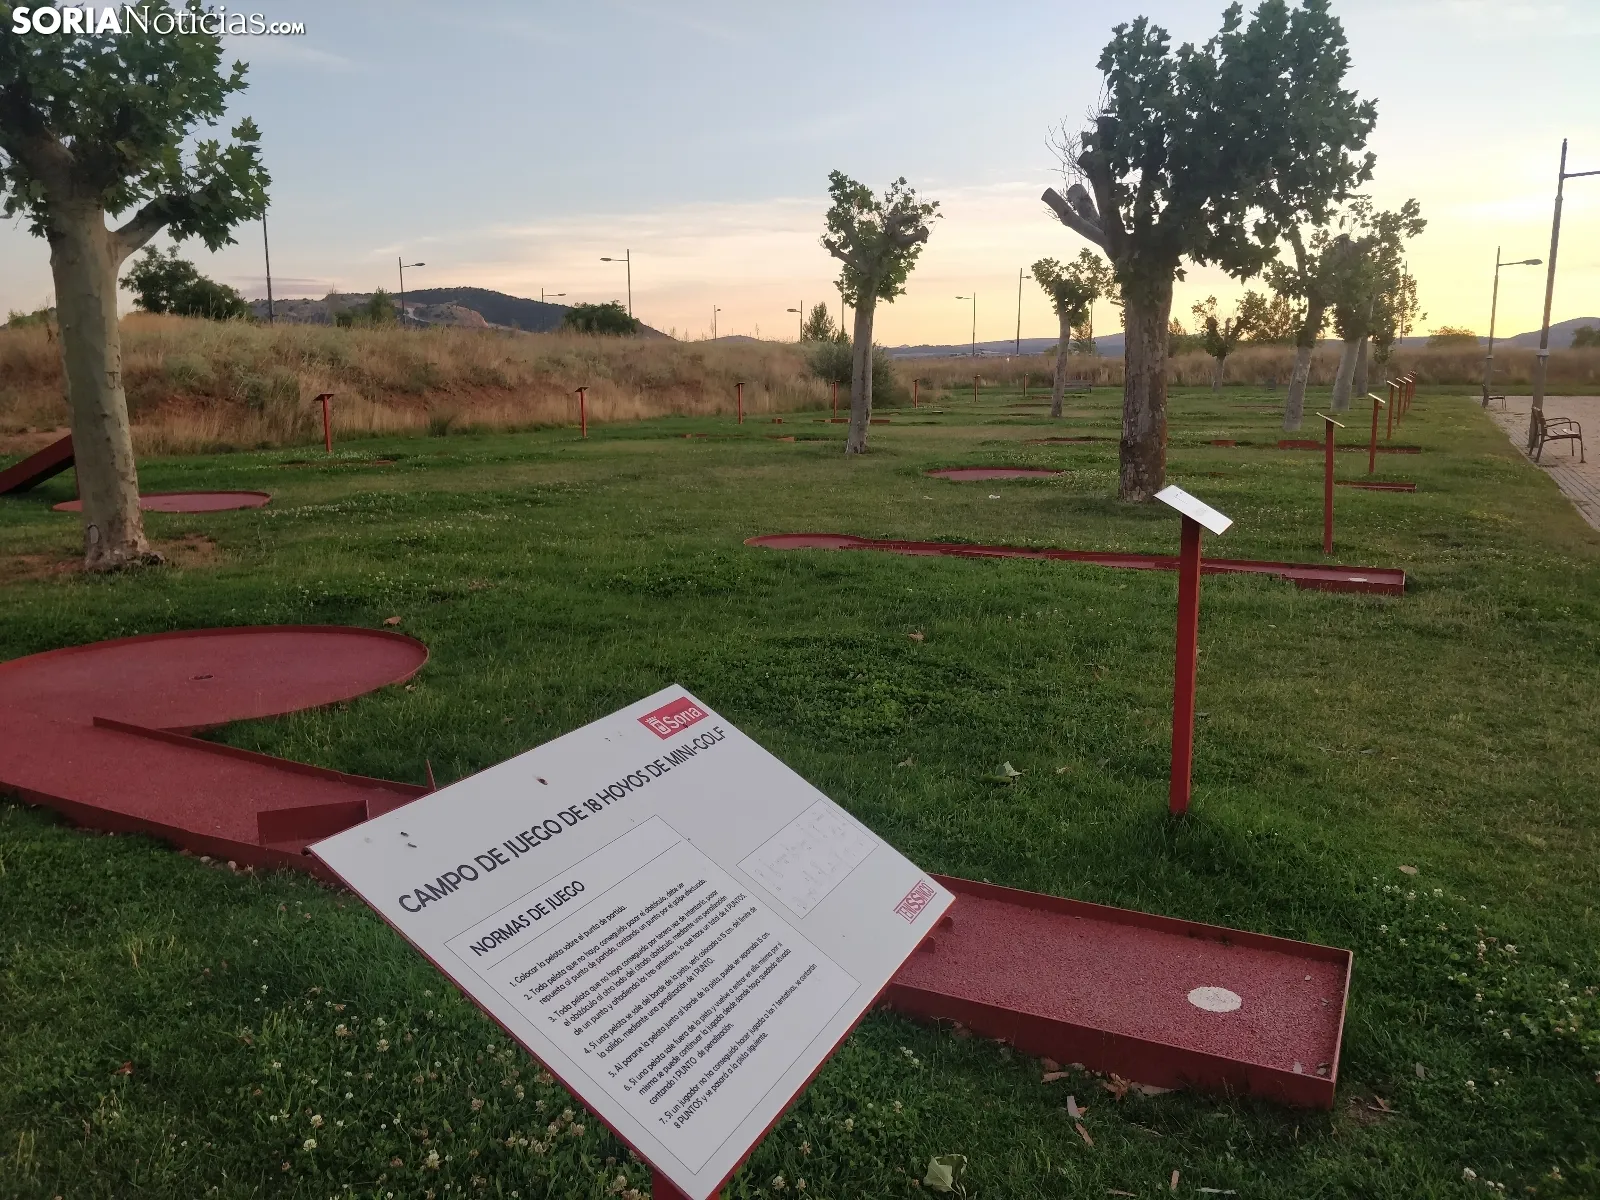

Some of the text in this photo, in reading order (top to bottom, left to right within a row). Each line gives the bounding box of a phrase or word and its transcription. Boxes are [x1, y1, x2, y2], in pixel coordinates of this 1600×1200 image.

[663, 707, 702, 729] Soria
[398, 726, 726, 913] CAMPO DE JUEGO DE 18 HOYOS DE MINI-GOLF
[469, 880, 585, 957] NORMAS DE JUEGO
[514, 965, 538, 983] Colocar
[544, 948, 564, 964] pelota
[562, 938, 579, 951] sobre
[577, 932, 585, 940] el
[582, 923, 600, 937] punto
[605, 905, 627, 921] partida.
[528, 982, 548, 995] Toda
[546, 968, 567, 985] pelota
[565, 960, 578, 971] que
[576, 955, 586, 963] no
[582, 944, 600, 957] haya
[599, 925, 627, 946] conseguido
[625, 914, 640, 928] pasar
[553, 1003, 572, 1017] Toda
[570, 990, 591, 1007] pelota
[589, 981, 602, 992] que
[600, 975, 609, 983] no
[605, 965, 623, 977] haya
[621, 944, 649, 967] conseguido
[647, 937, 657, 947] por
[564, 977, 572, 986] al
[570, 967, 589, 982] punto
[595, 946, 618, 964] partida,
[615, 928, 640, 947] contando
[645, 913, 661, 926] punto
[563, 939, 674, 1026] el obstáculo al otro lado del citado obstáculo,
[573, 1027, 584, 1036] de
[581, 1020, 592, 1029] un
[590, 1007, 608, 1024] punto
[611, 981, 640, 1005] añadiendo
[636, 975, 647, 983] los
[644, 968, 656, 978] tres
[683, 937, 694, 946] que
[690, 928, 704, 940] hace
[595, 1032, 610, 1044] una
[607, 1018, 627, 1036] pelota
[631, 1004, 643, 1015] sale
[641, 995, 652, 1006] del
[648, 984, 666, 999] borde
[676, 964, 691, 977] pista,
[688, 954, 700, 966] será
[622, 1015, 649, 1038] mediante
[647, 1006, 660, 1016] una
[657, 981, 688, 1009] penalización
[685, 975, 694, 983] de
[680, 997, 698, 1012] borde
[647, 1026, 666, 1044] pelota
[662, 1014, 679, 1029] junto
[677, 1007, 685, 1016] al
[614, 1062, 624, 1072] Al
[635, 1068, 649, 1080] una
[646, 1052, 666, 1071] pelota
[663, 1043, 676, 1054] sale
[672, 1030, 689, 1045] fuera
[687, 1024, 696, 1032] de
[638, 1076, 659, 1095] misma
[662, 1055, 681, 1074] puede
[678, 1033, 702, 1057] continuar
[640, 1040, 650, 1048] la
[608, 1070, 617, 1078] 5.
[649, 1079, 675, 1104] contando
[674, 1056, 697, 1078] PUNTO
[671, 1104, 681, 1113] un
[677, 1084, 700, 1107] jugador
[676, 1097, 703, 1124] PUNTOS
